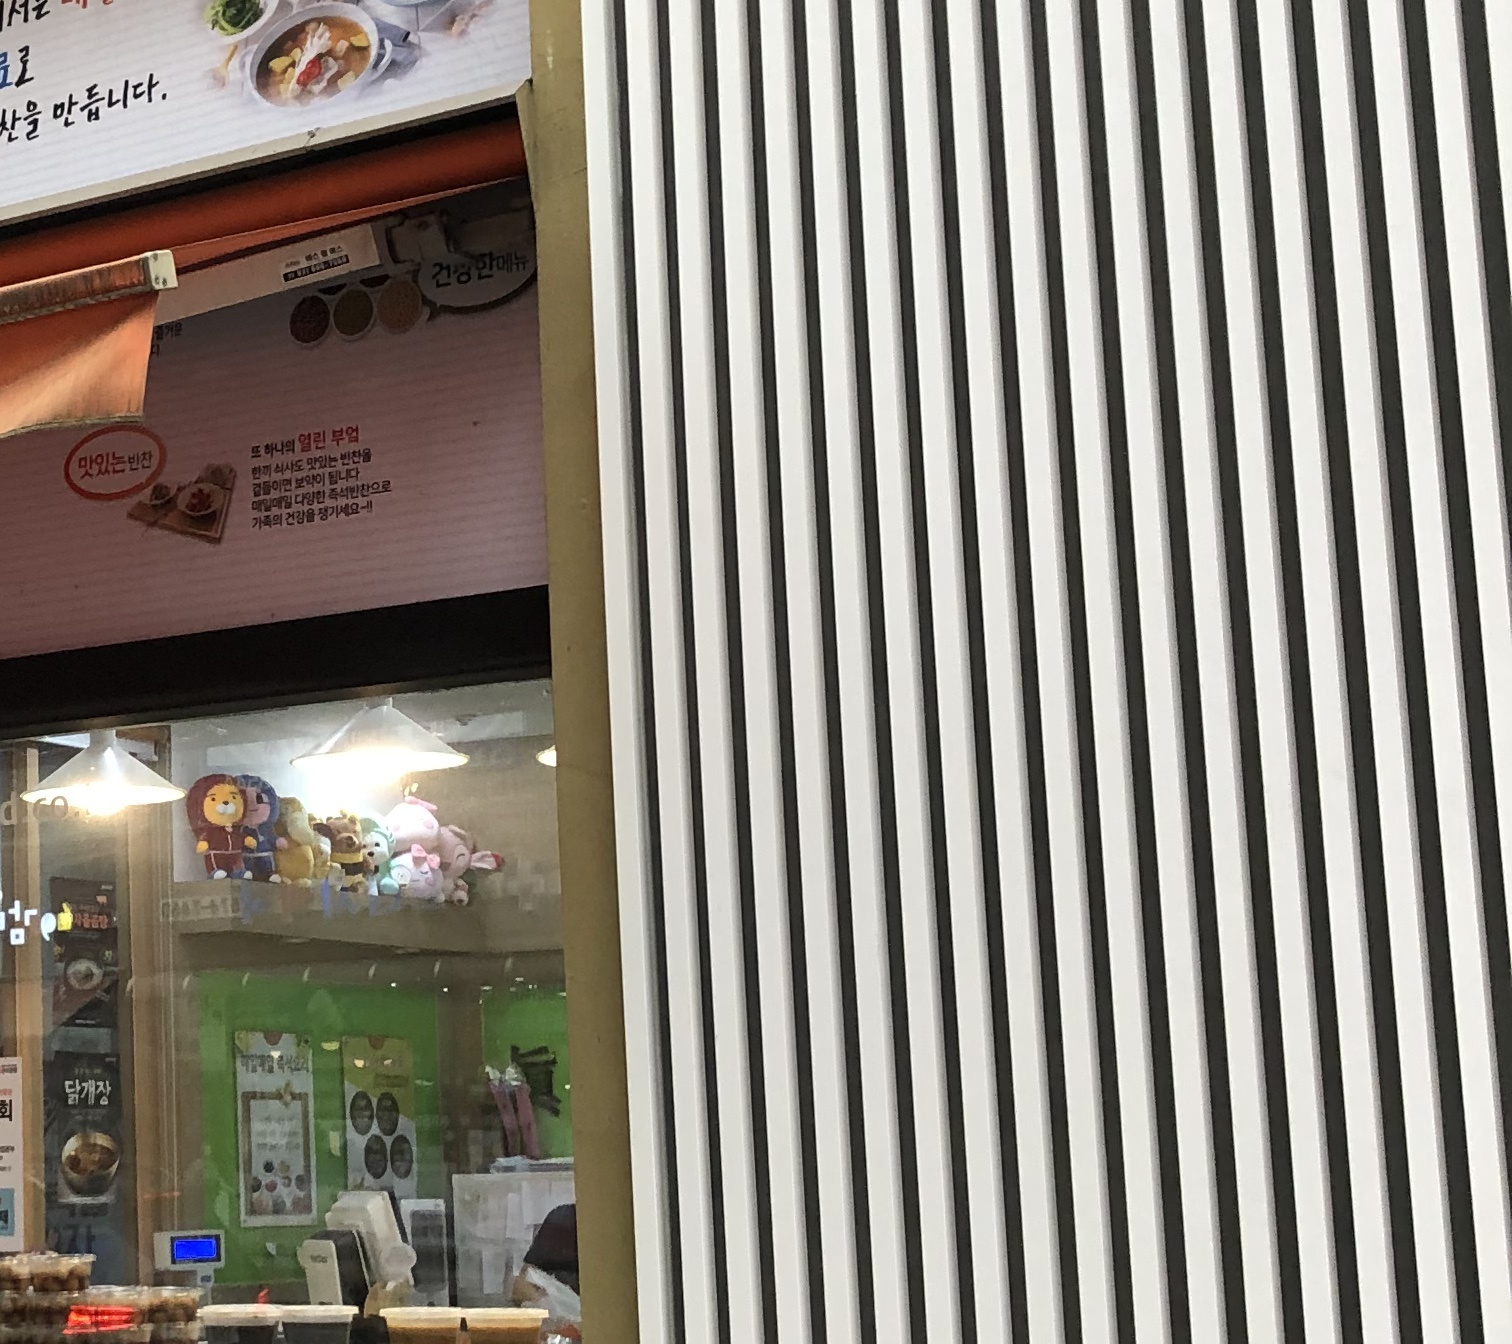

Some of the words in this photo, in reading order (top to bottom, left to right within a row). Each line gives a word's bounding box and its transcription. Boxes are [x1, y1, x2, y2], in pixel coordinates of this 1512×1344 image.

[52, 72, 169, 126] 만듭니다.
[251, 444, 262, 460] 또
[263, 439, 296, 459] 하나의
[251, 464, 272, 480] 한끼
[273, 459, 305, 476] 식사도
[306, 454, 339, 471] 맛있는
[339, 447, 372, 465] 반찬을
[76, 452, 126, 481] 맛있는
[126, 449, 153, 472] 반찬
[294, 471, 326, 490] 보약이
[328, 467, 360, 485] 됩니다
[251, 494, 293, 513] 매일매일
[294, 490, 326, 508] 다양한
[327, 480, 392, 502] 즉석반찬으로
[251, 515, 283, 531] 가족의
[284, 508, 316, 526] 건강을
[64, 1079, 112, 1106] 닭개장
